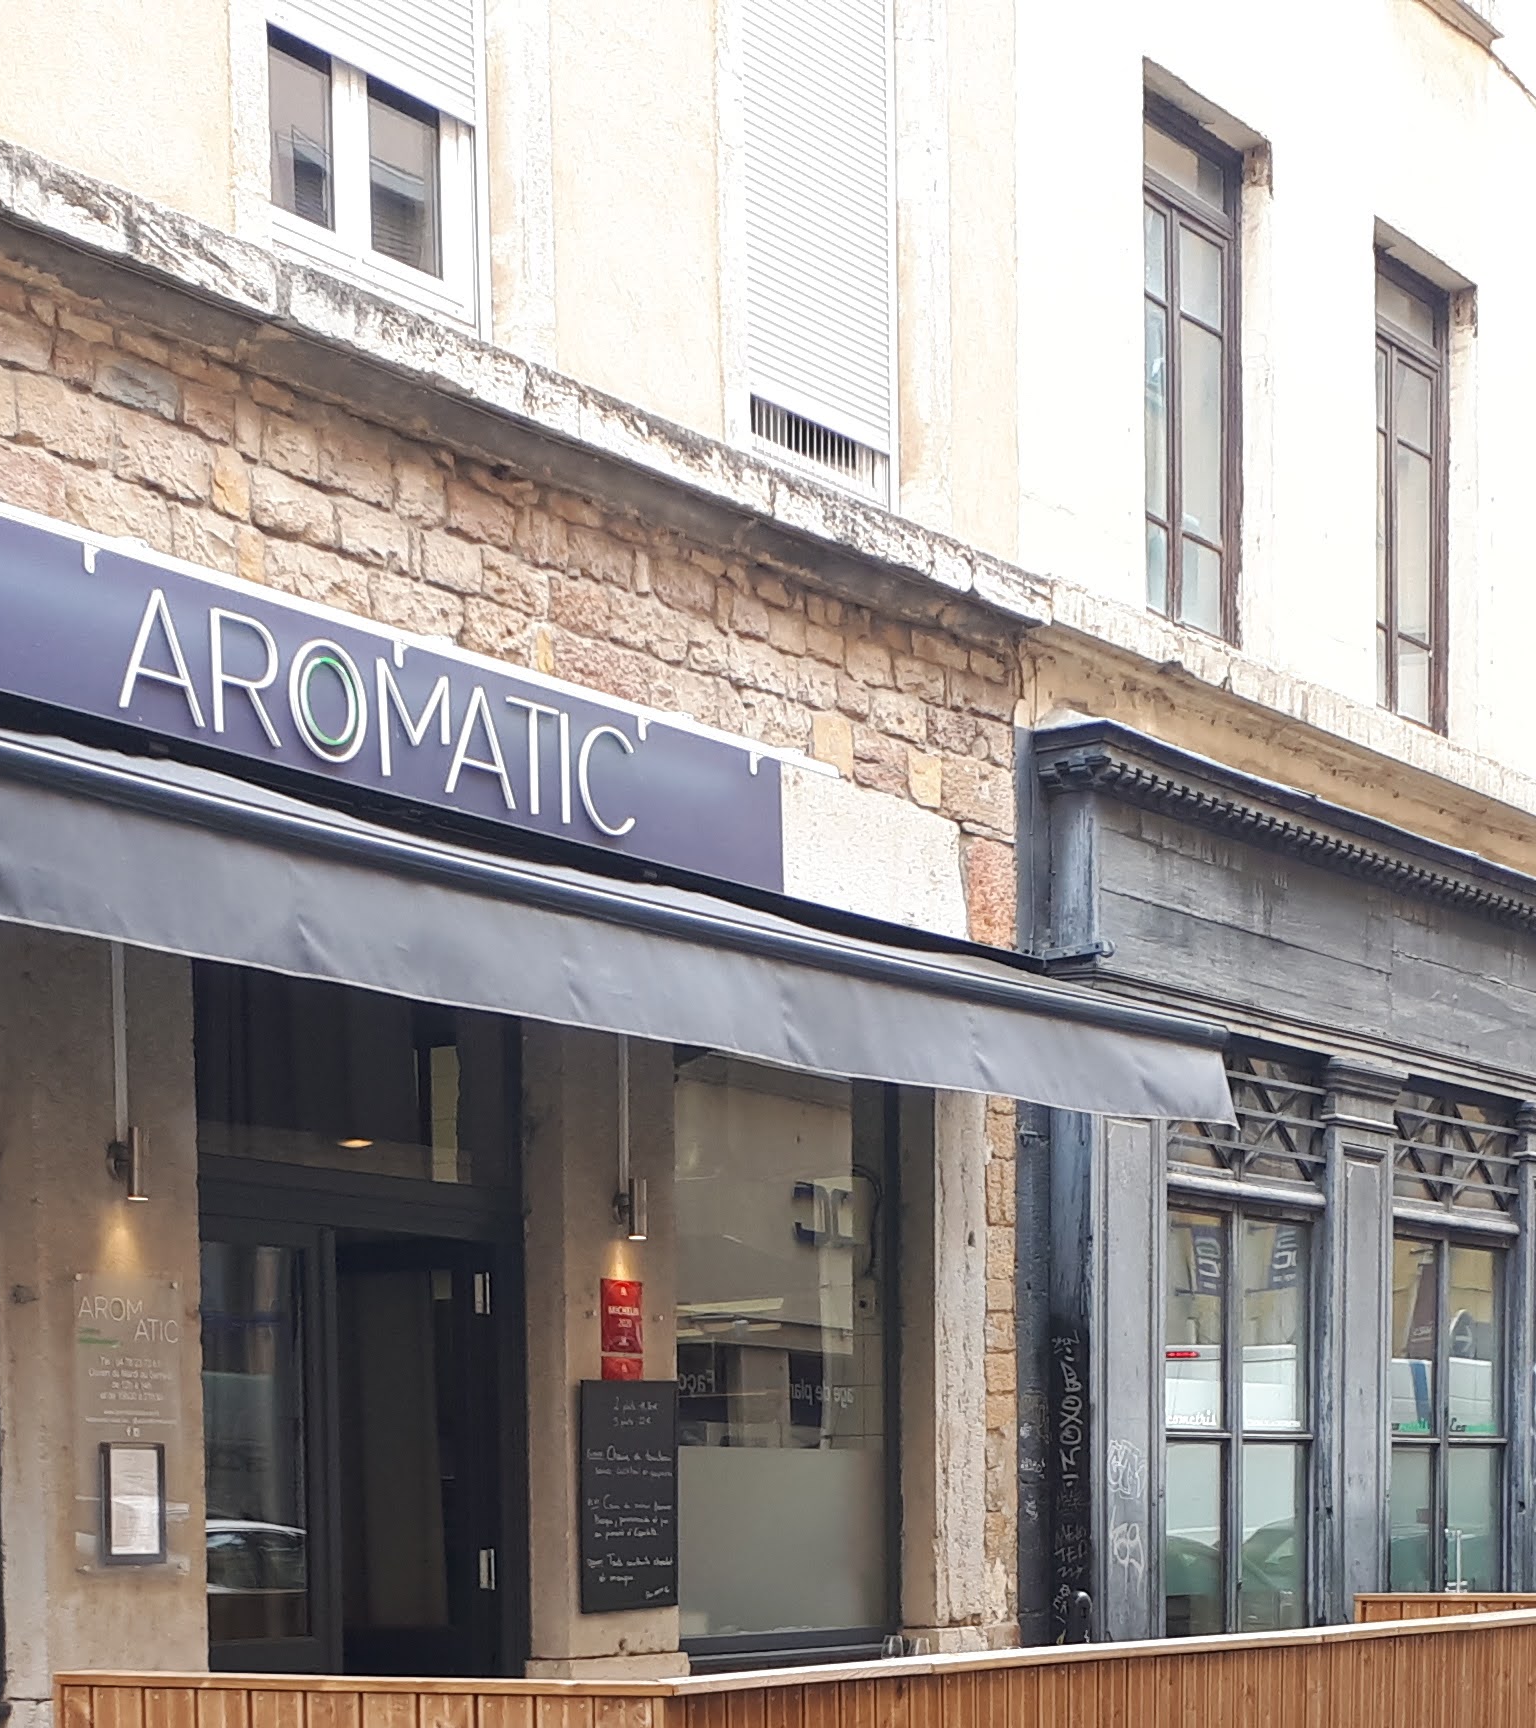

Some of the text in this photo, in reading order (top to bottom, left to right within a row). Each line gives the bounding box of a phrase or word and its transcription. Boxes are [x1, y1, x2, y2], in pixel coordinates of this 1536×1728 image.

[119, 588, 637, 838] AROMATIC
[78, 1296, 143, 1321] AROM
[134, 1318, 178, 1343] ATIC
